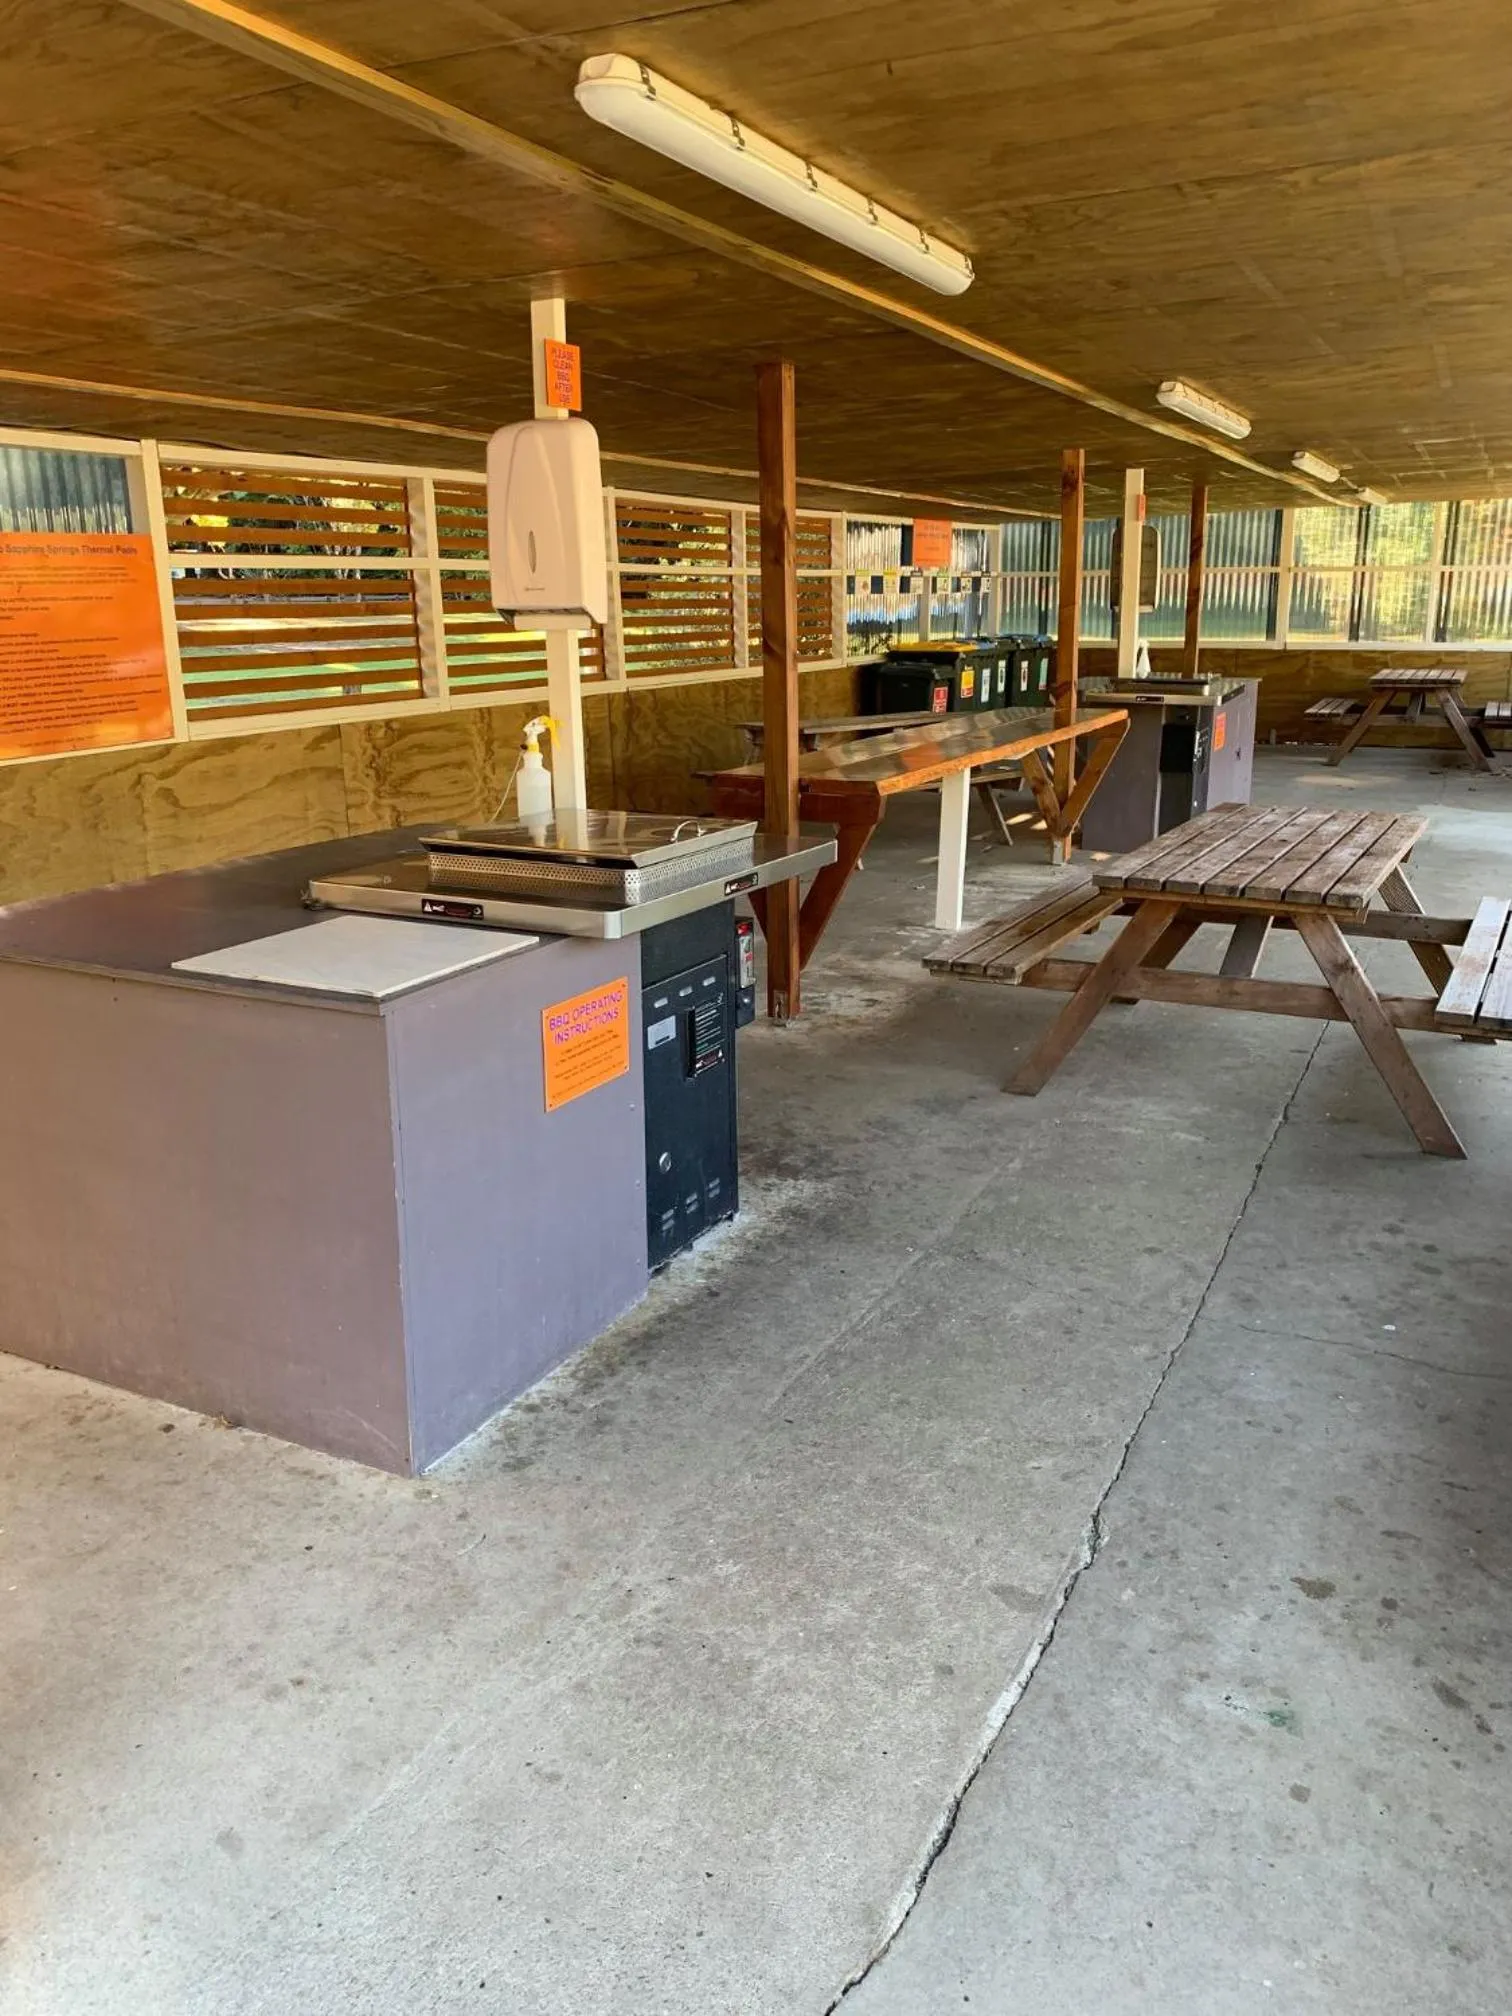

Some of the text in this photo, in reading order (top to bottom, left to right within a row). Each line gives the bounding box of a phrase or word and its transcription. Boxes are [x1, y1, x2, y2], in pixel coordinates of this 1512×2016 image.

[81, 544, 114, 554] Thermal
[549, 990, 622, 1031] BBQ OPERATING
[555, 1007, 619, 1044] INSTRUCTIONS
